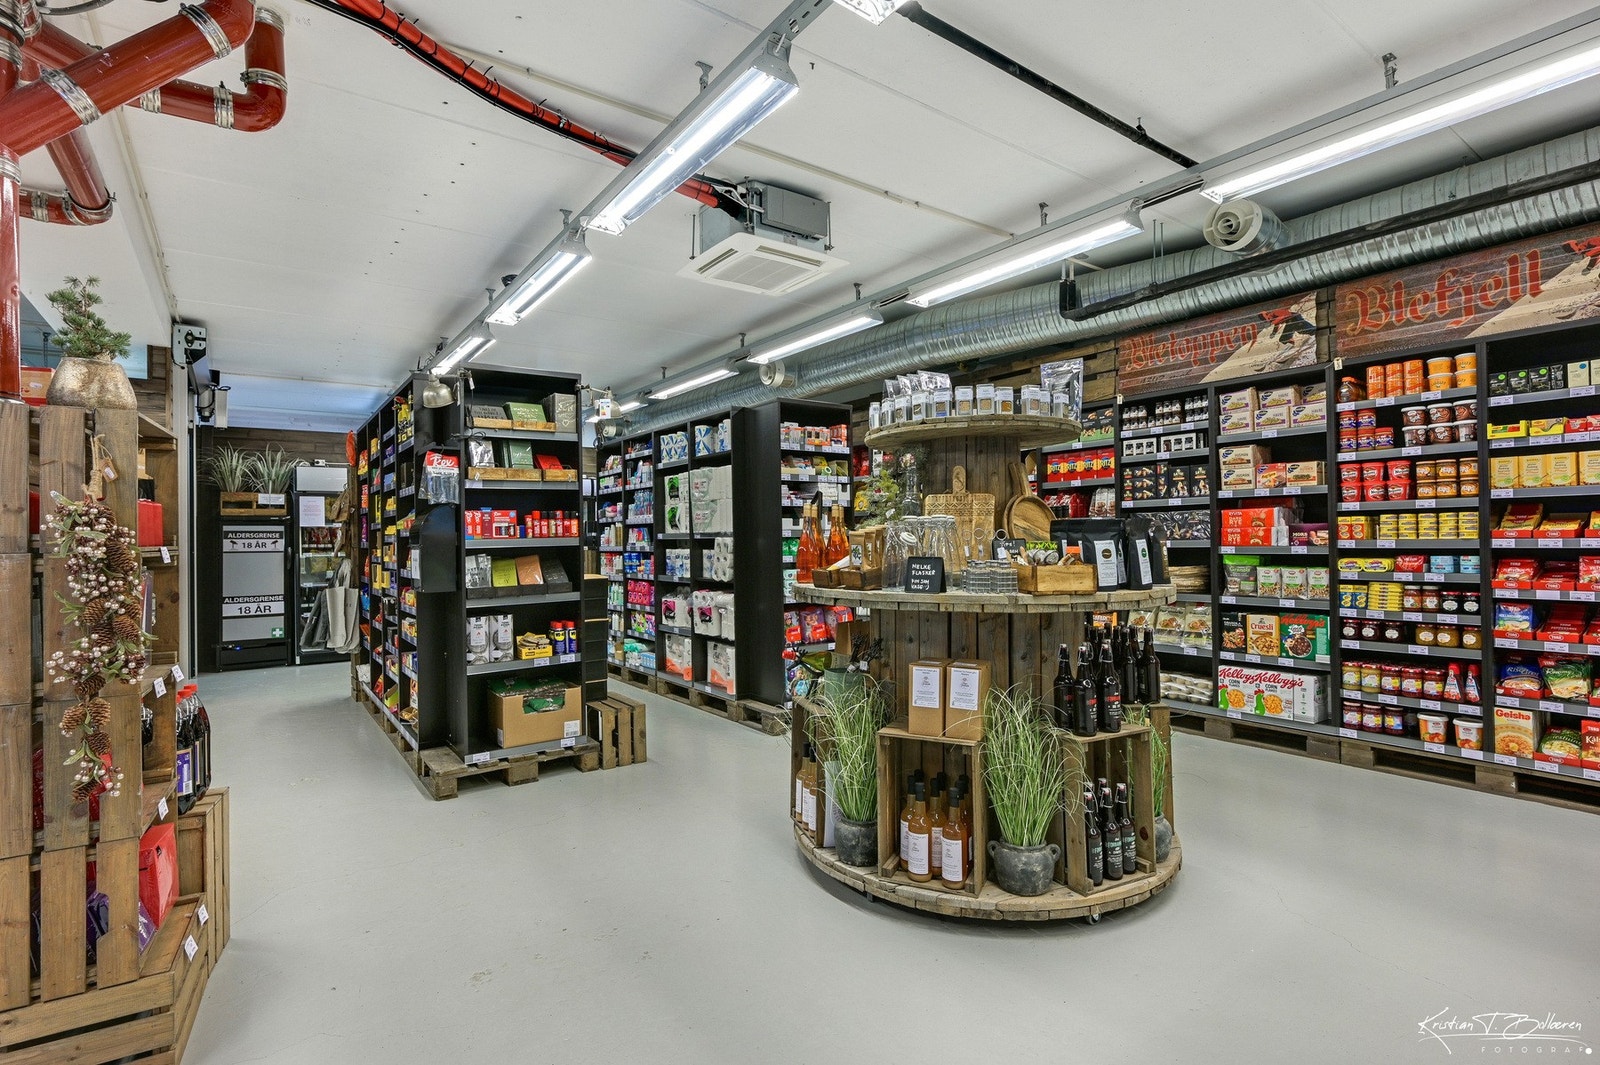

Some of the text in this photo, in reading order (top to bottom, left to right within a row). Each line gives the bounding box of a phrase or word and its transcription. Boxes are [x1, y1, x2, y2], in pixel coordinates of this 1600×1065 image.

[1346, 249, 1544, 336] Blefjell
[254, 540, 267, 549] ÅR
[224, 595, 284, 604] ALDERSGRENSE
[238, 604, 272, 614] 18 ÅR
[1496, 709, 1531, 721] Geisha
